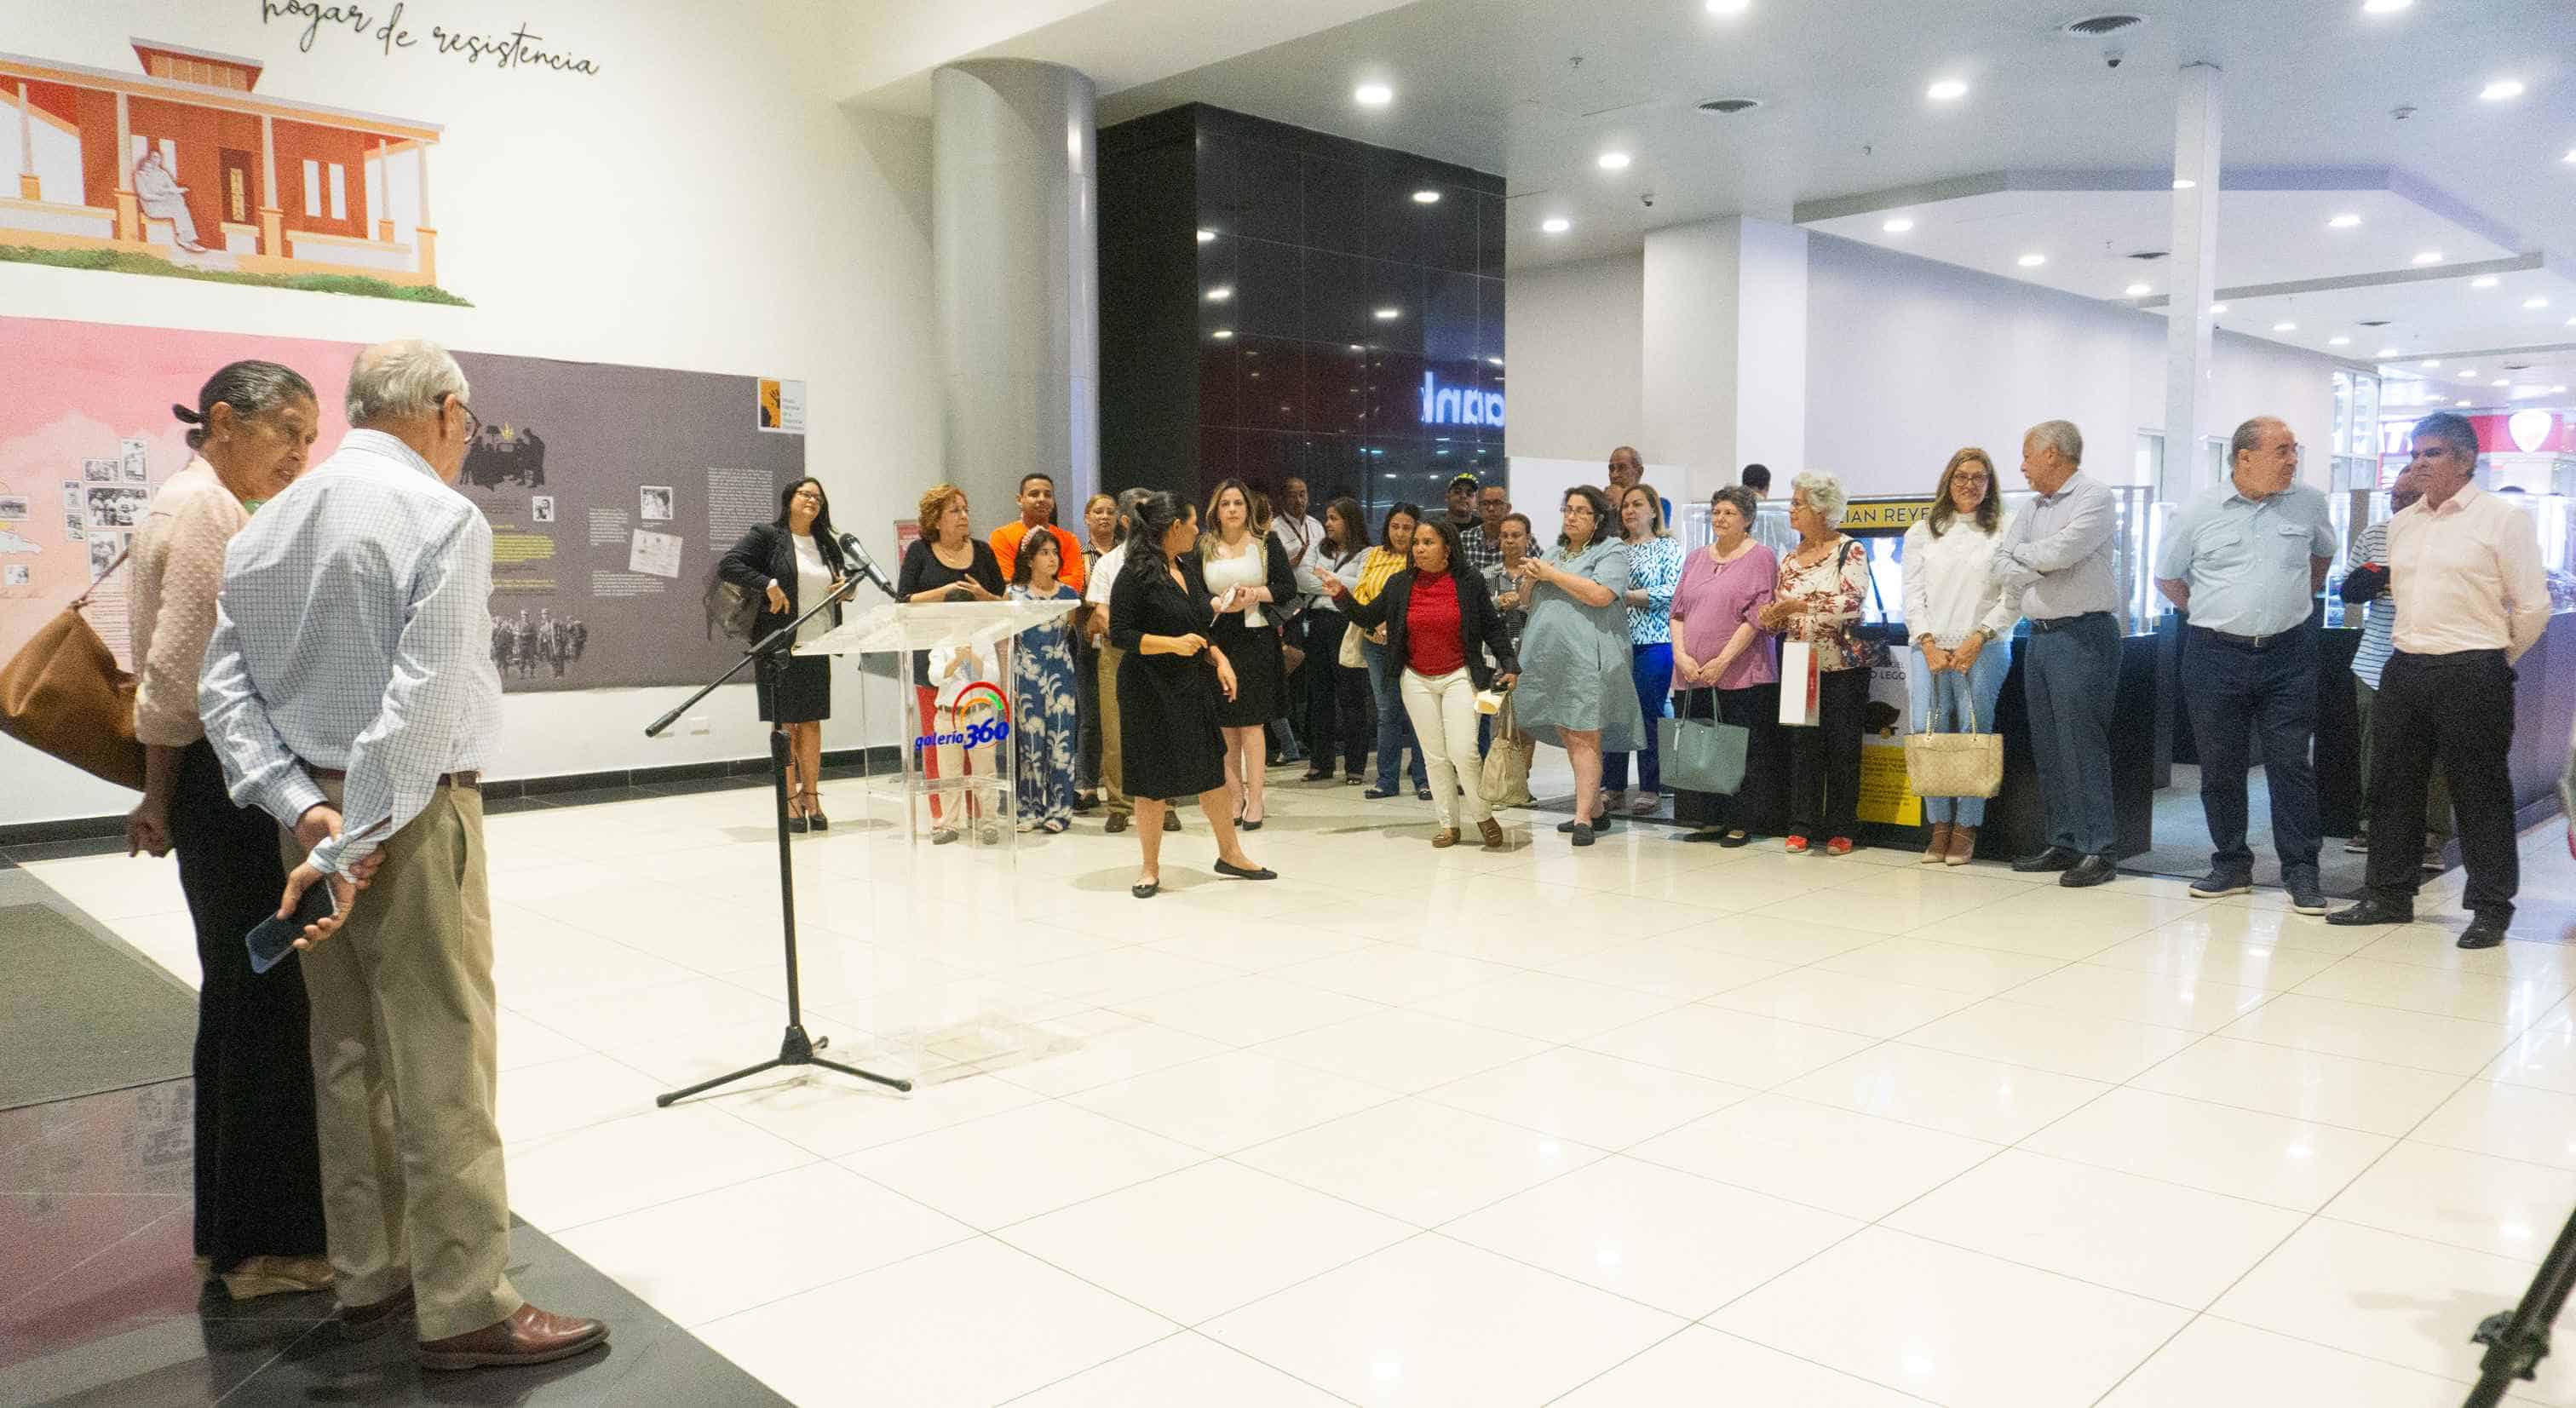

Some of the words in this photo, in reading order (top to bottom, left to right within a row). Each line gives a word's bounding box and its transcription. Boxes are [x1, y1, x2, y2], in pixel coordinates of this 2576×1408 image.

[376, 3, 418, 56] de
[432, 22, 600, 76] resistencia
[963, 717, 1009, 750] 360
